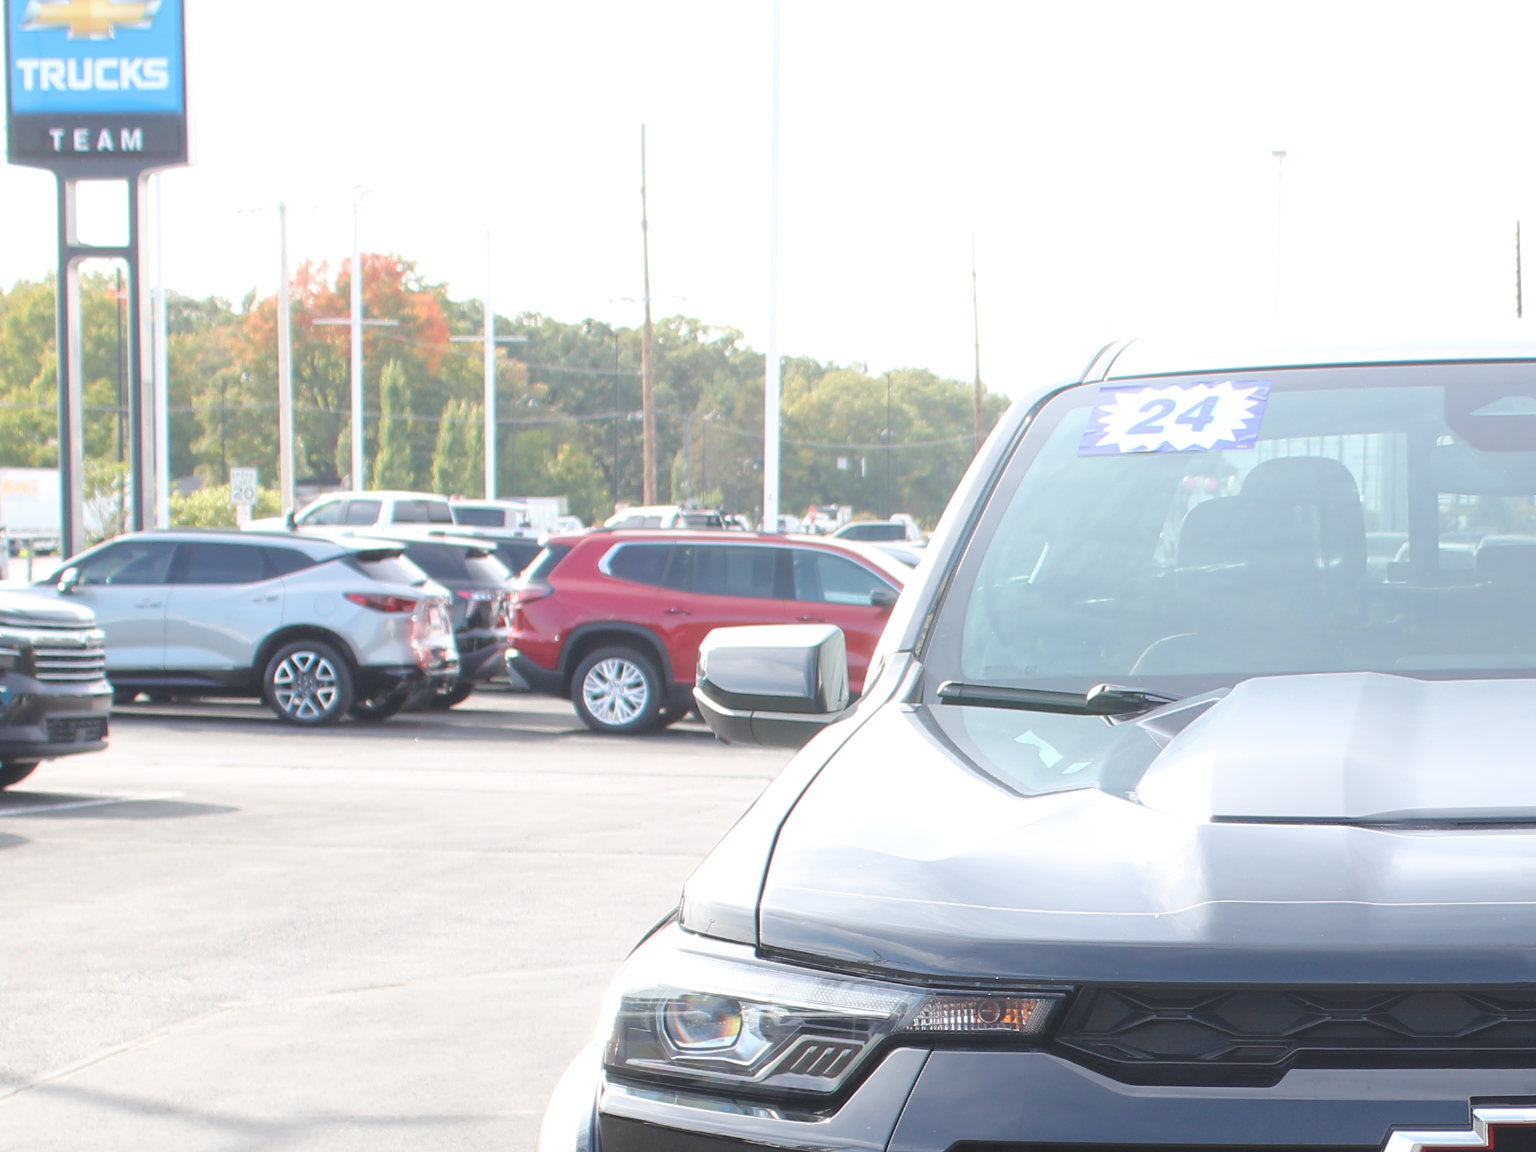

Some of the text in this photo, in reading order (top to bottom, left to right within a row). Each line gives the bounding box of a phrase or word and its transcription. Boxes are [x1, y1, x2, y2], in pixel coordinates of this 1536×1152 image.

[16, 57, 169, 91] TRUCKS
[49, 128, 144, 151] TEAM
[1125, 395, 1220, 435] 24
